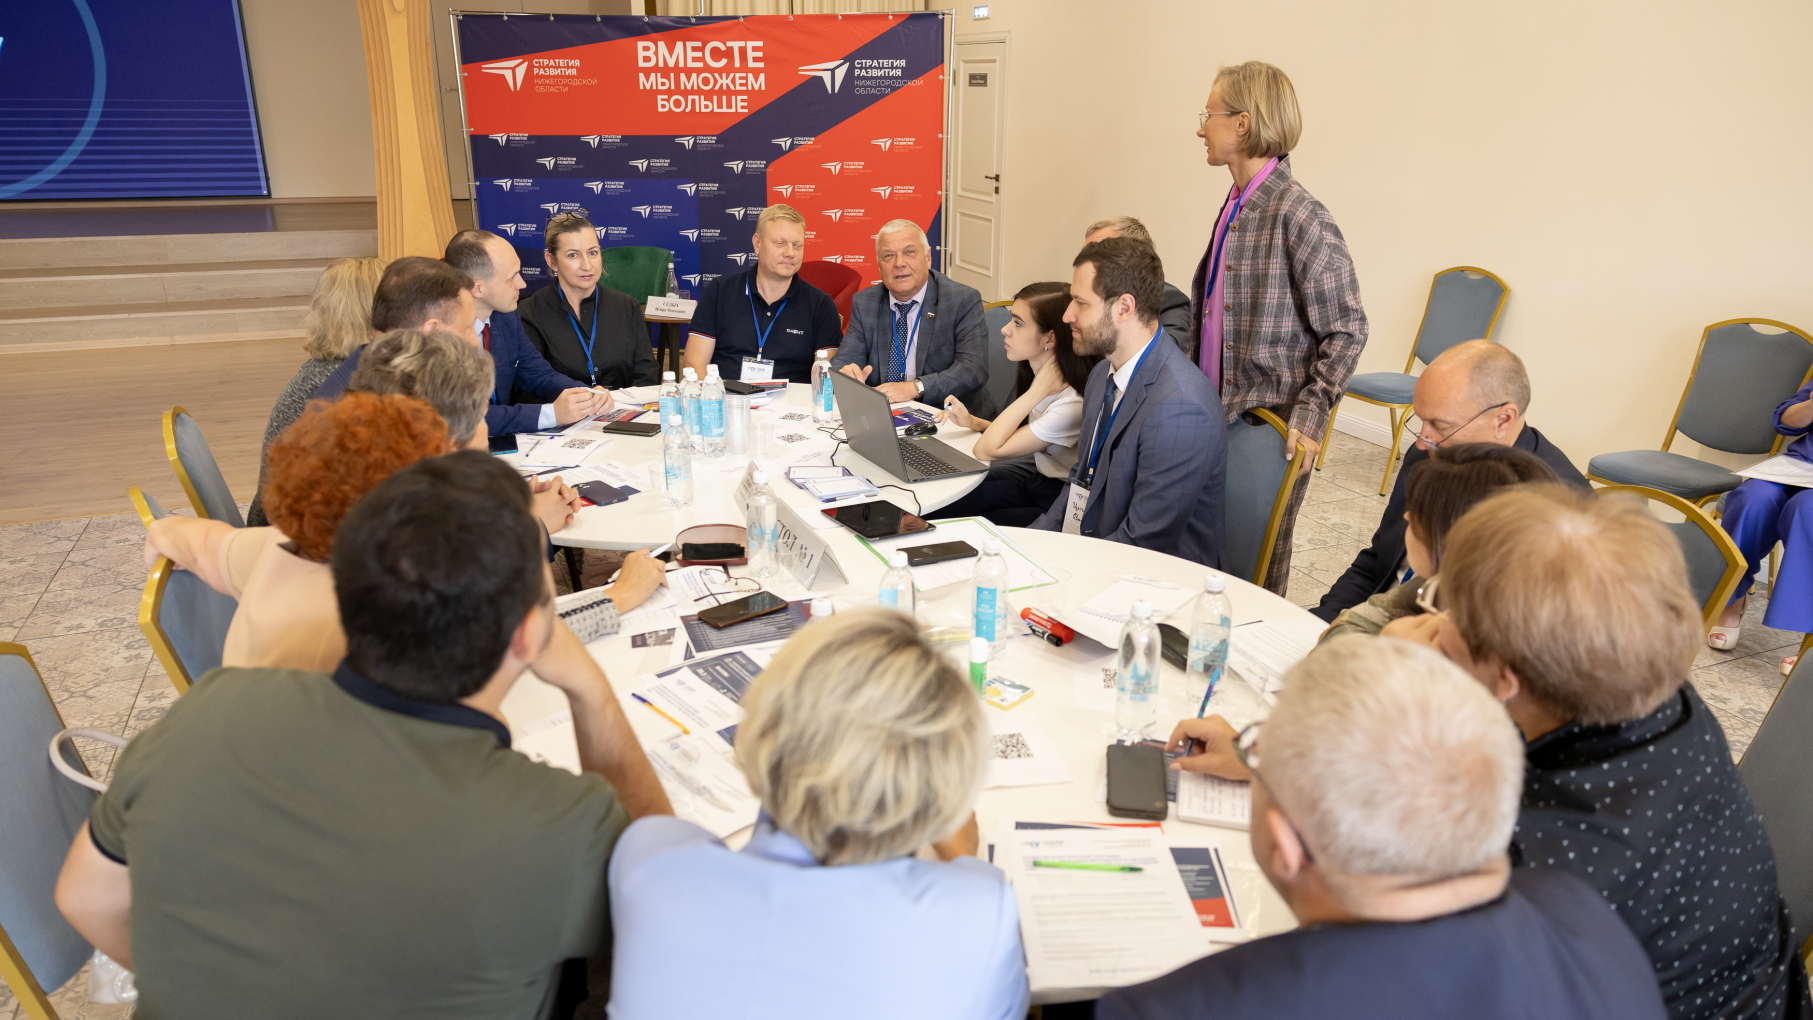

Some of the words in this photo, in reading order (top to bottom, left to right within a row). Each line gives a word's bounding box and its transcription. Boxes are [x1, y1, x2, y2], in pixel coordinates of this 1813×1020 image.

[637, 41, 765, 68] ВМЕСТЕ
[533, 59, 580, 67] СТРАТЕГИЯ
[854, 59, 906, 68] СТРАТЕГИЯ
[533, 68, 577, 76] РАЗВИТИЯ
[854, 69, 902, 77] РАЗВИТИЯ
[534, 77, 598, 86] НИЖЕГОРОДСКОЙ
[639, 72, 675, 90] МЫ
[680, 72, 765, 91] МОЖЕМ
[854, 78, 923, 87] НИЖЕГОРОДСКОЙ
[535, 85, 568, 93] ОБЛАСТИ
[854, 87, 891, 95] ОБЛАСТИ
[657, 95, 748, 113] БОЛЬШЕ
